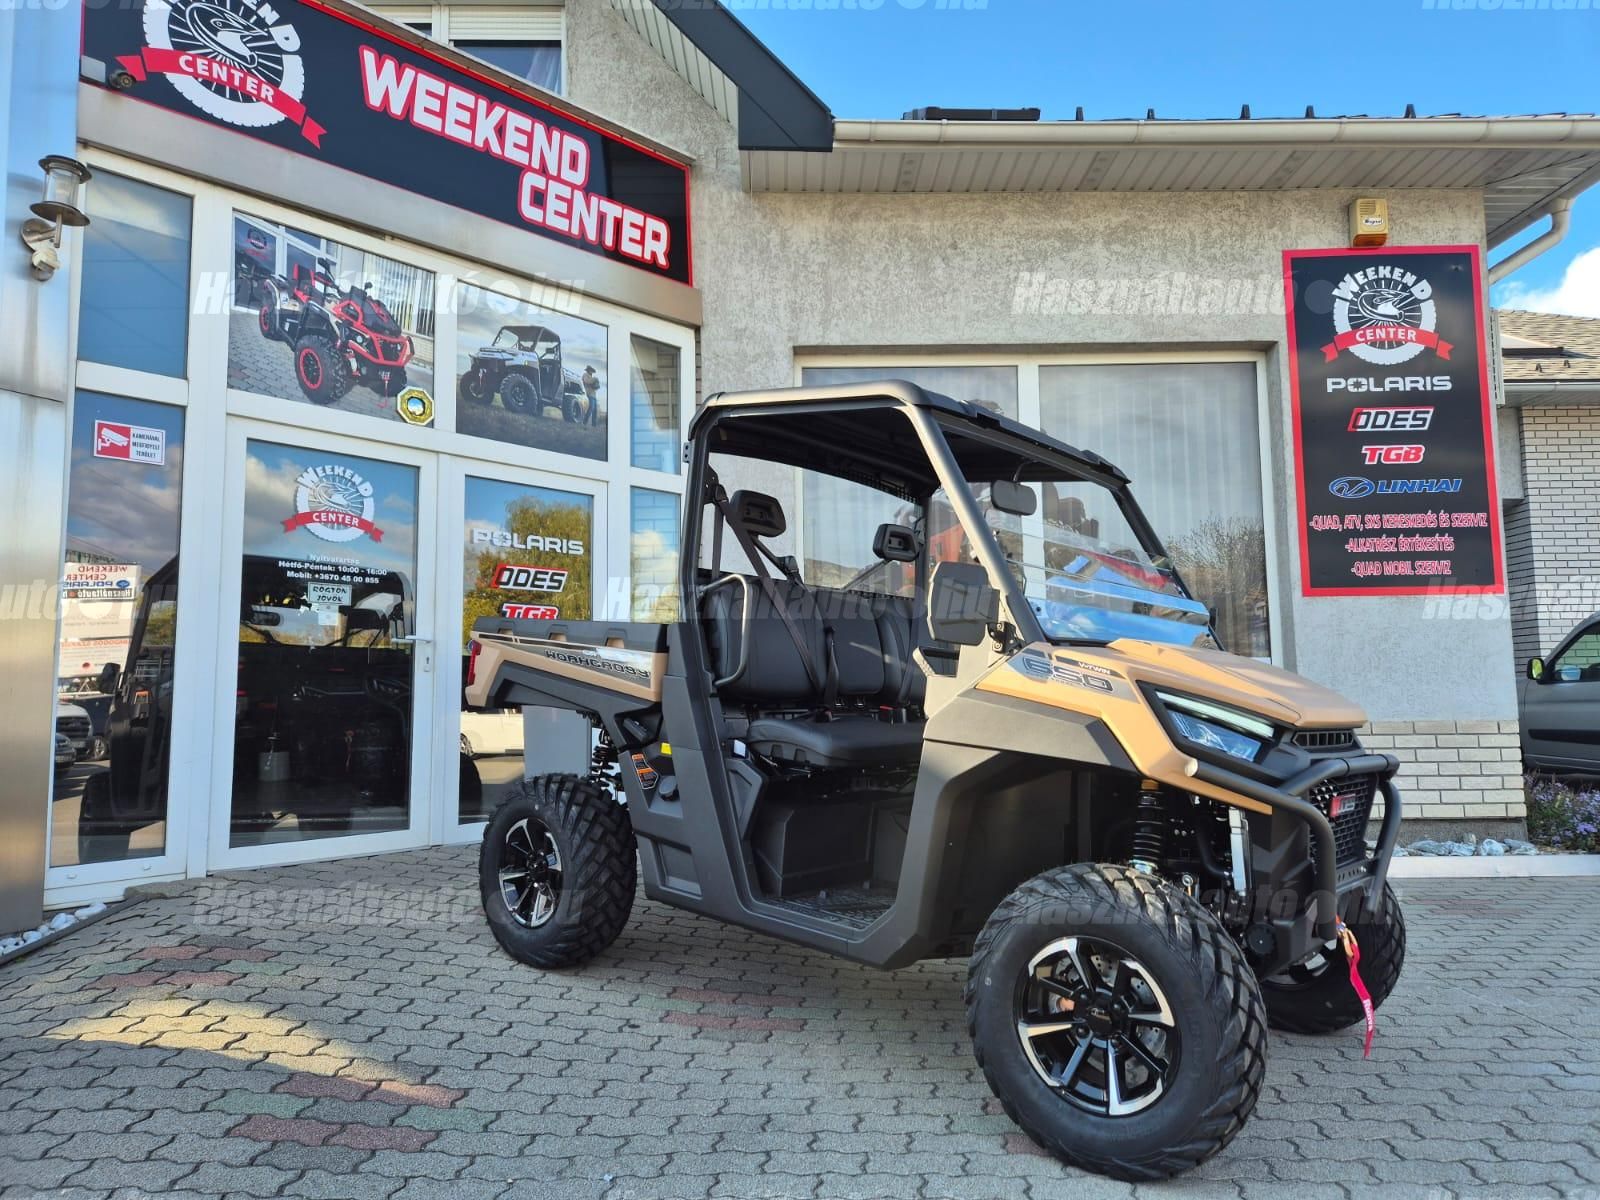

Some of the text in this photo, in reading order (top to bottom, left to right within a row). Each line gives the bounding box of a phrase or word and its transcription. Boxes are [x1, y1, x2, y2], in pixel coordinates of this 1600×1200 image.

[179, 55, 275, 102] CENTER
[360, 46, 589, 188] WEEKEND
[518, 168, 670, 269] CENTER
[1332, 265, 1433, 301] WEEKEND
[1355, 327, 1417, 342] CENTER
[1326, 376, 1452, 393] POLARIS
[1349, 407, 1433, 431] ODES
[1361, 444, 1425, 465] TGB
[297, 465, 374, 497] WEEKEND
[1376, 479, 1462, 494] LINHAI
[312, 512, 359, 527] CENTER
[1451, 513, 1488, 528] SZERVIZ
[471, 528, 584, 555] POLARIS
[286, 570, 312, 579] Mobil:
[338, 565, 360, 574] 10:00
[367, 568, 388, 576] 16:00
[492, 564, 568, 592] ODES
[1383, 560, 1414, 575] MOBIL
[1415, 560, 1452, 575] SZERVIZ
